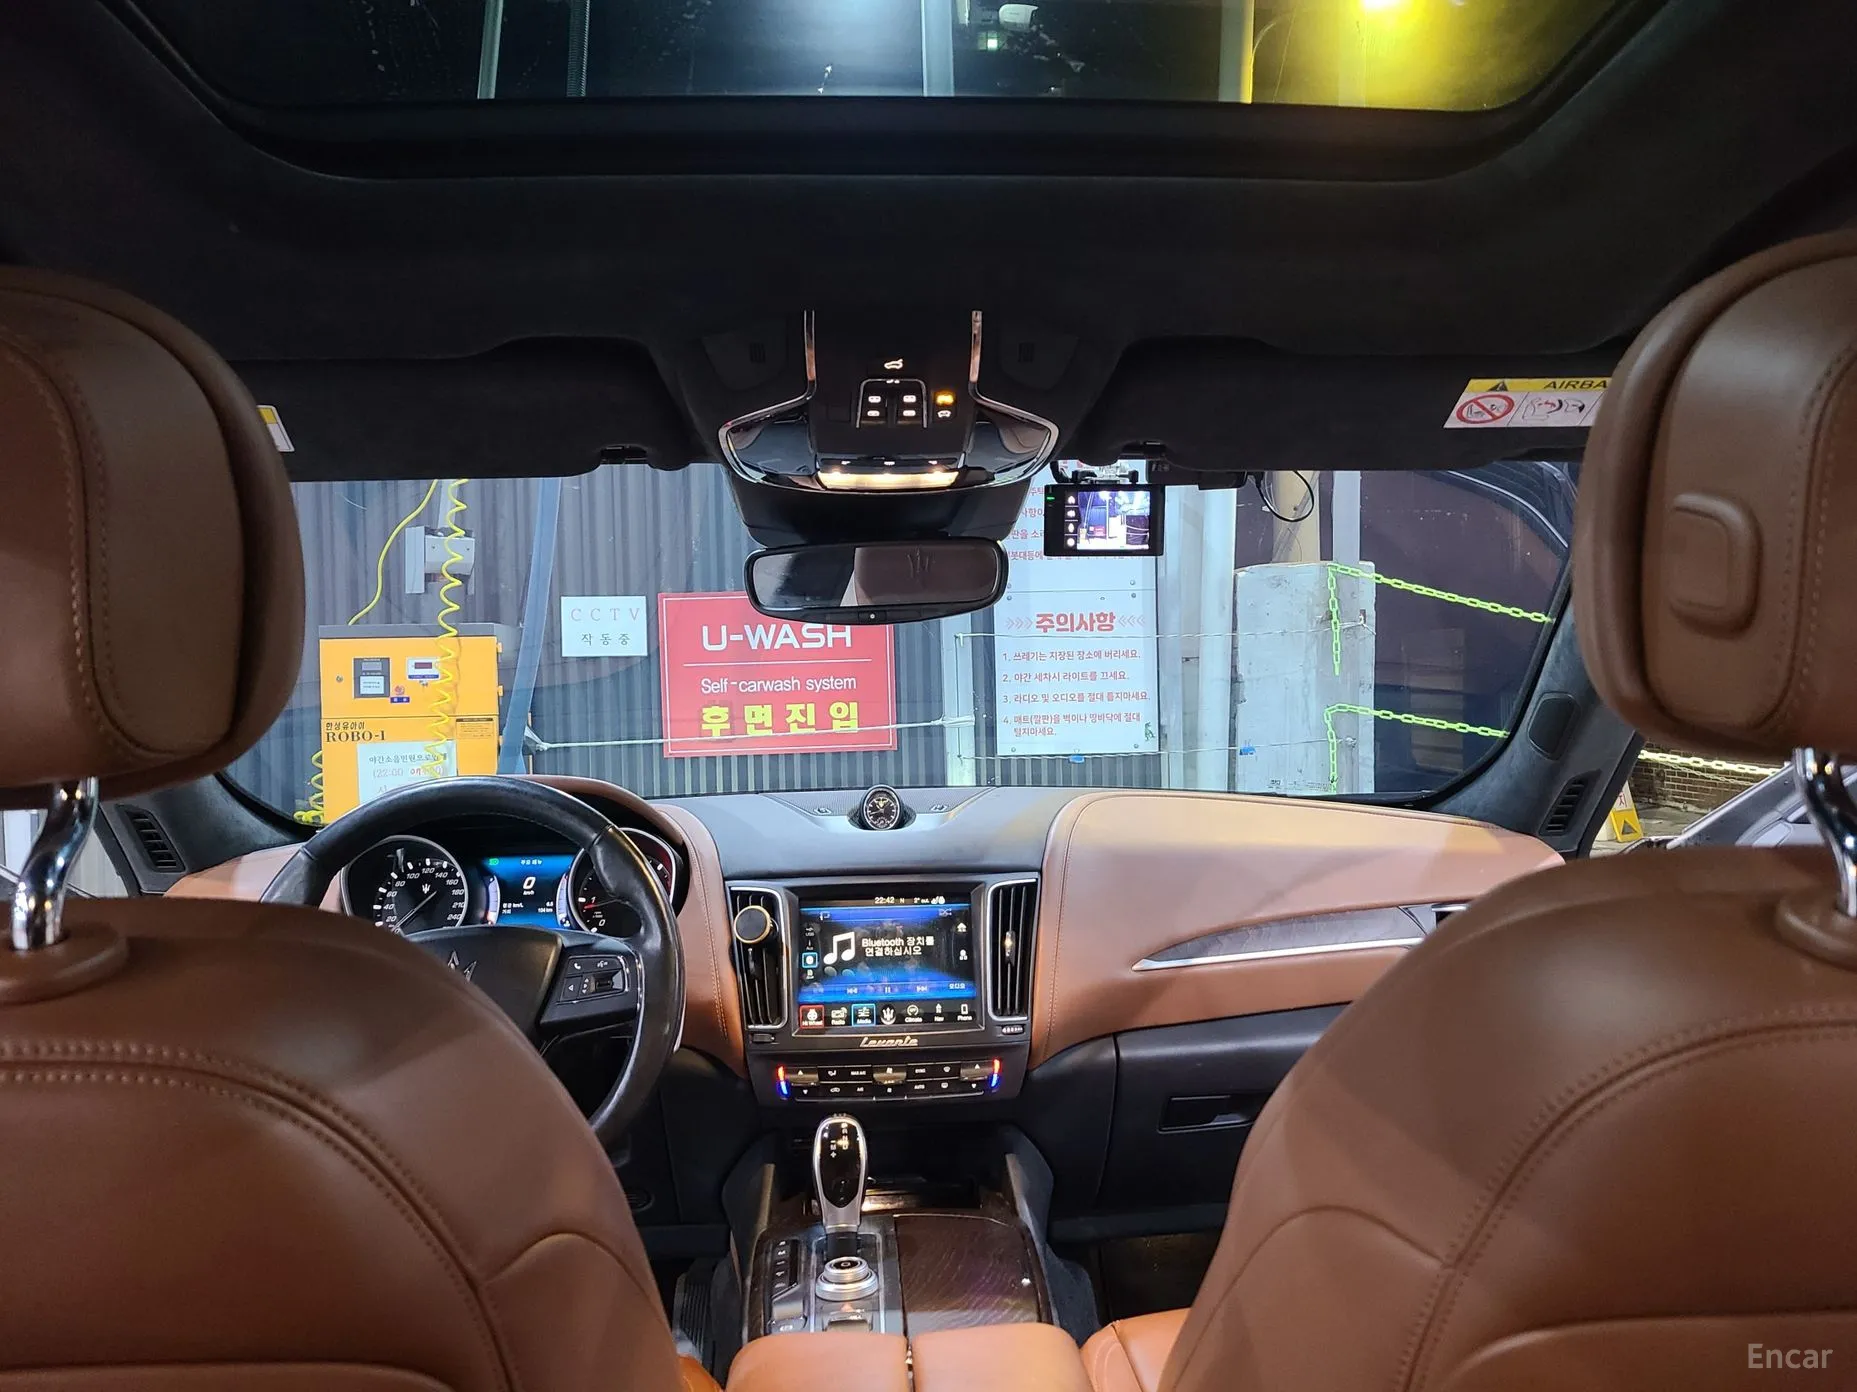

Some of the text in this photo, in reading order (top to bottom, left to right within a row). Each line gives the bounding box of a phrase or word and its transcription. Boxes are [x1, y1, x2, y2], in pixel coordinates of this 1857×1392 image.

[1543, 380, 1607, 389] AIRBA
[571, 608, 640, 621] CCTV
[1035, 612, 1116, 633] 주의사항
[581, 633, 630, 646] 작동중
[702, 623, 851, 651] U-WASH
[1013, 651, 1047, 661] 쓰레기는
[1014, 673, 1031, 683] 야간
[1034, 672, 1060, 682] 세차시
[806, 675, 857, 693] system
[1014, 693, 1039, 704] 라디오
[523, 877, 536, 889] 0
[599, 919, 605, 927] 0
[862, 938, 904, 947] Bluetooth
[865, 946, 922, 957] 연결하십시오
[860, 1036, 918, 1048] Levante
